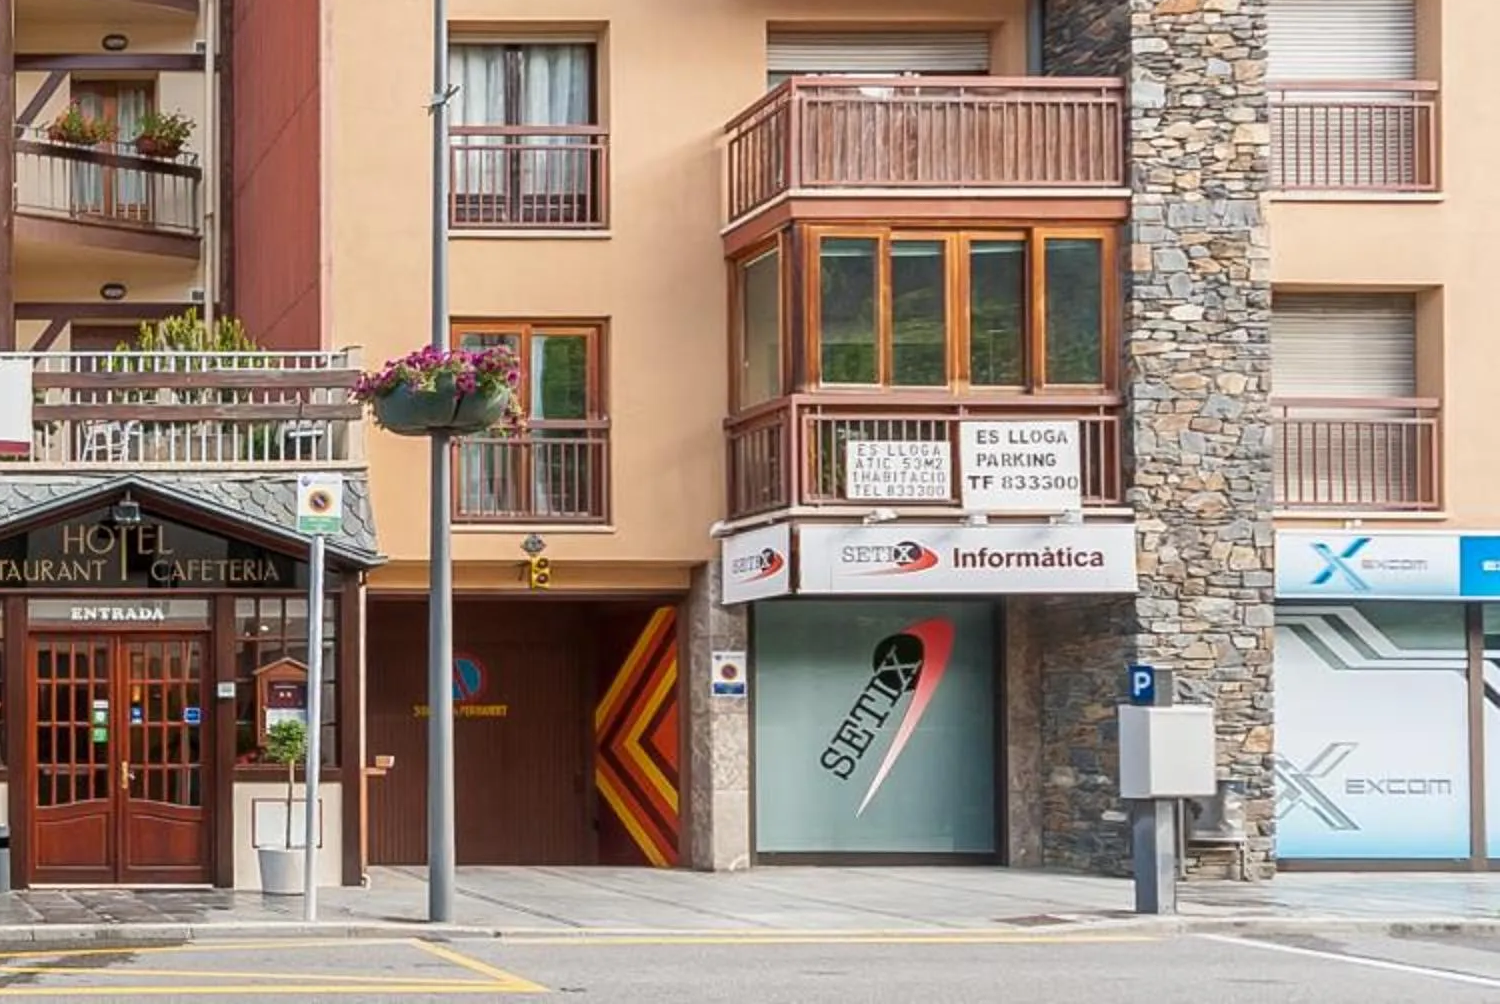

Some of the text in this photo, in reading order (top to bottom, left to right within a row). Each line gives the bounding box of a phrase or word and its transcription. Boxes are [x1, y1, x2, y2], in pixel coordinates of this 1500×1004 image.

[976, 430, 1069, 444] ES LLOGA
[857, 444, 941, 456] ES LLOGA
[855, 458, 944, 469] ATIC 53M2
[976, 453, 1057, 467] PARKING
[854, 484, 945, 496] TEL 833300
[967, 475, 1078, 490] TF 833300
[62, 524, 174, 581] HOTEL
[841, 544, 1105, 568] SETIX Informàtica
[731, 549, 775, 574] SETIX
[151, 559, 280, 582] CAFETERIA
[70, 607, 165, 621] ENTRADA
[1133, 671, 1151, 696] P
[819, 644, 923, 781] SETIX
[1345, 778, 1452, 794] EXCOM
